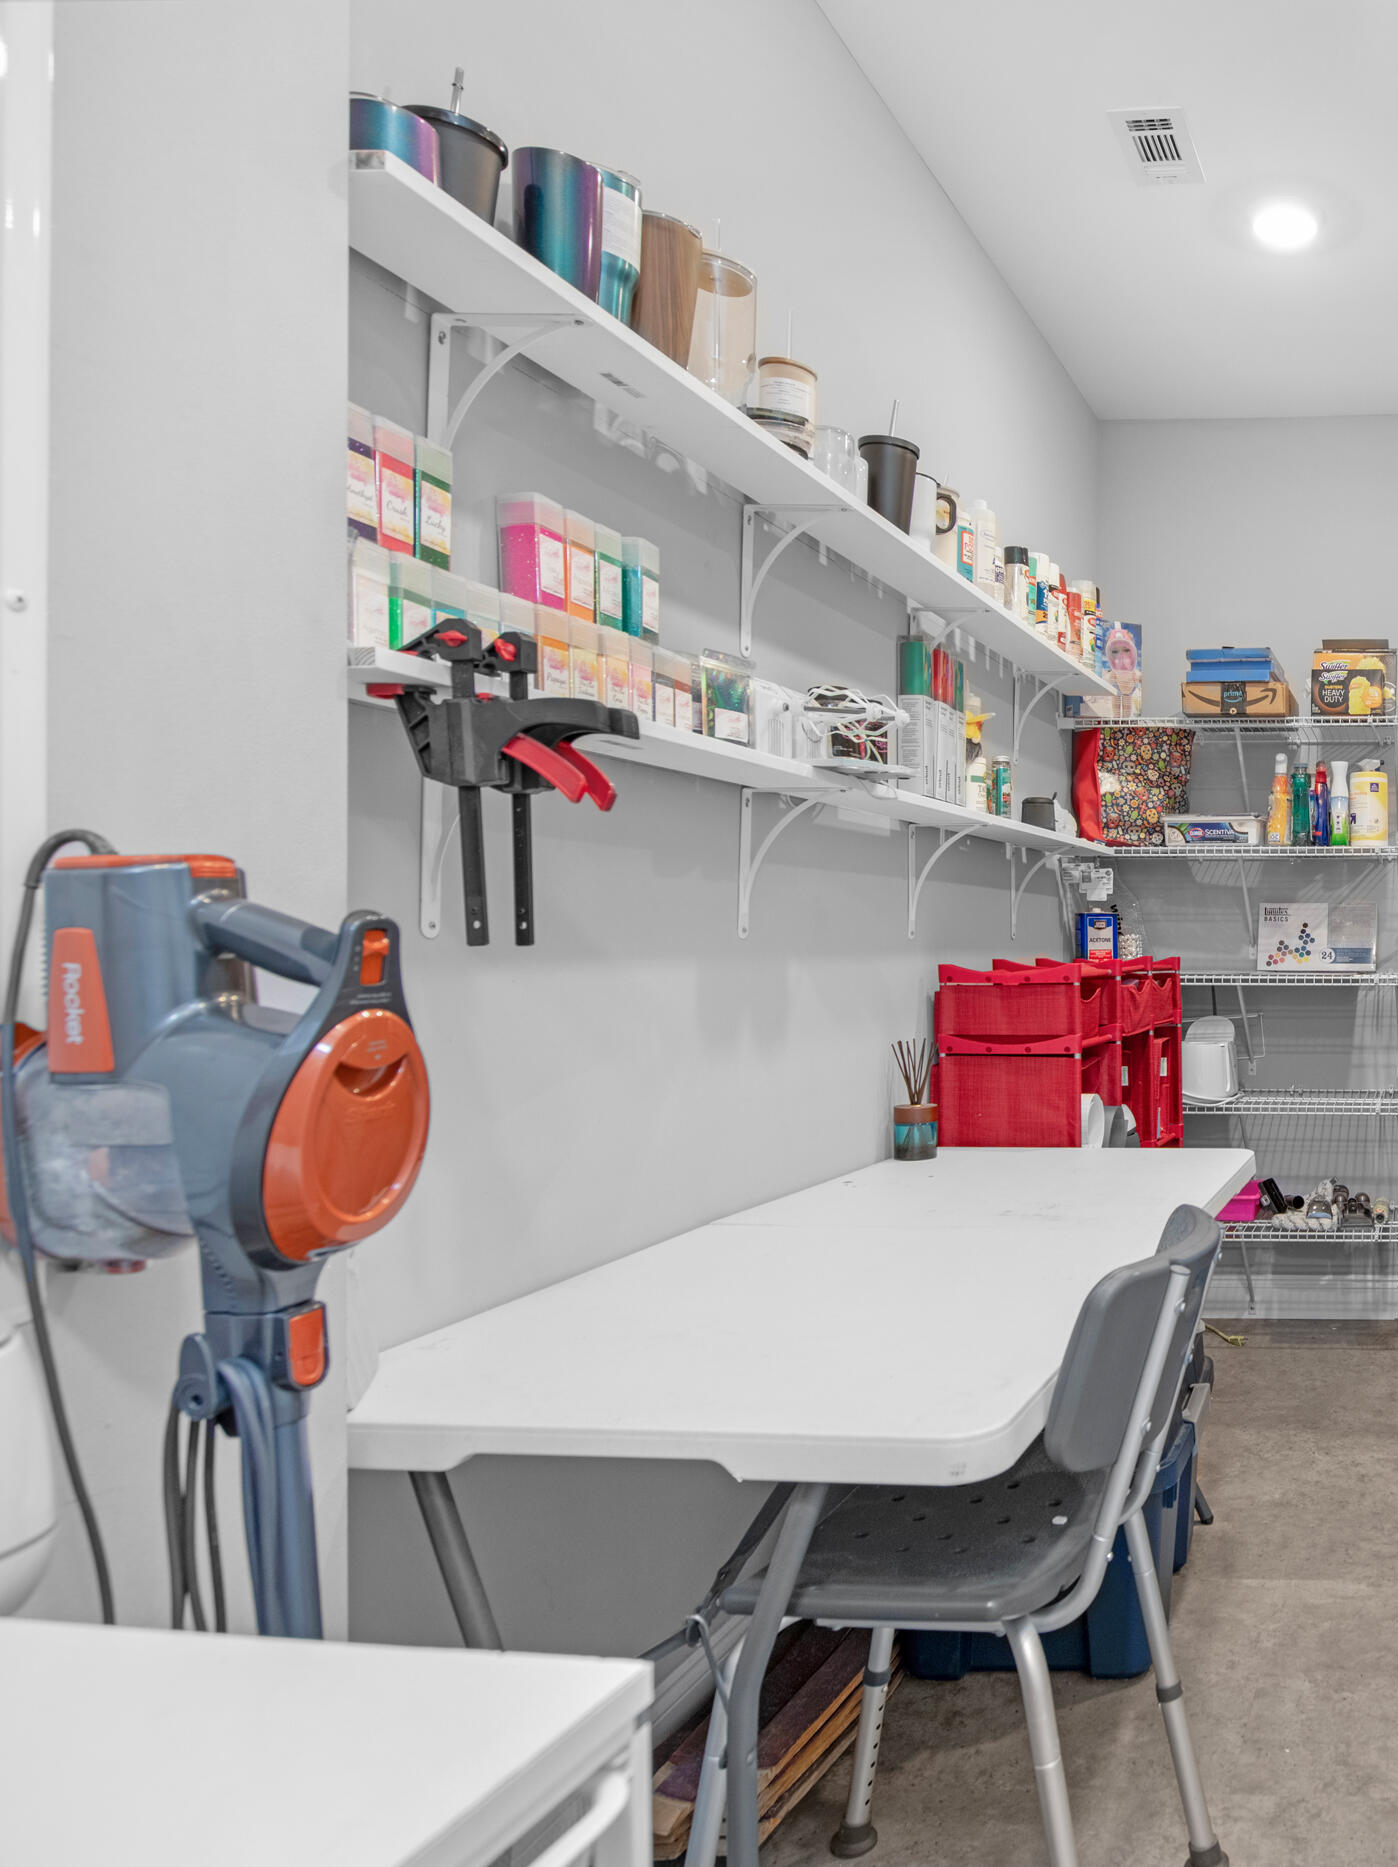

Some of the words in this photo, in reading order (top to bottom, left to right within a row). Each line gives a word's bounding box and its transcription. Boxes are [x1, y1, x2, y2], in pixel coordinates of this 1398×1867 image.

[425, 516, 446, 534] Lucky
[1320, 661, 1348, 670] Swiffer
[1320, 671, 1345, 682] Swiffer
[1223, 690, 1243, 698] prime
[1321, 952, 1333, 960] 24
[61, 962, 86, 1045] Rocket
